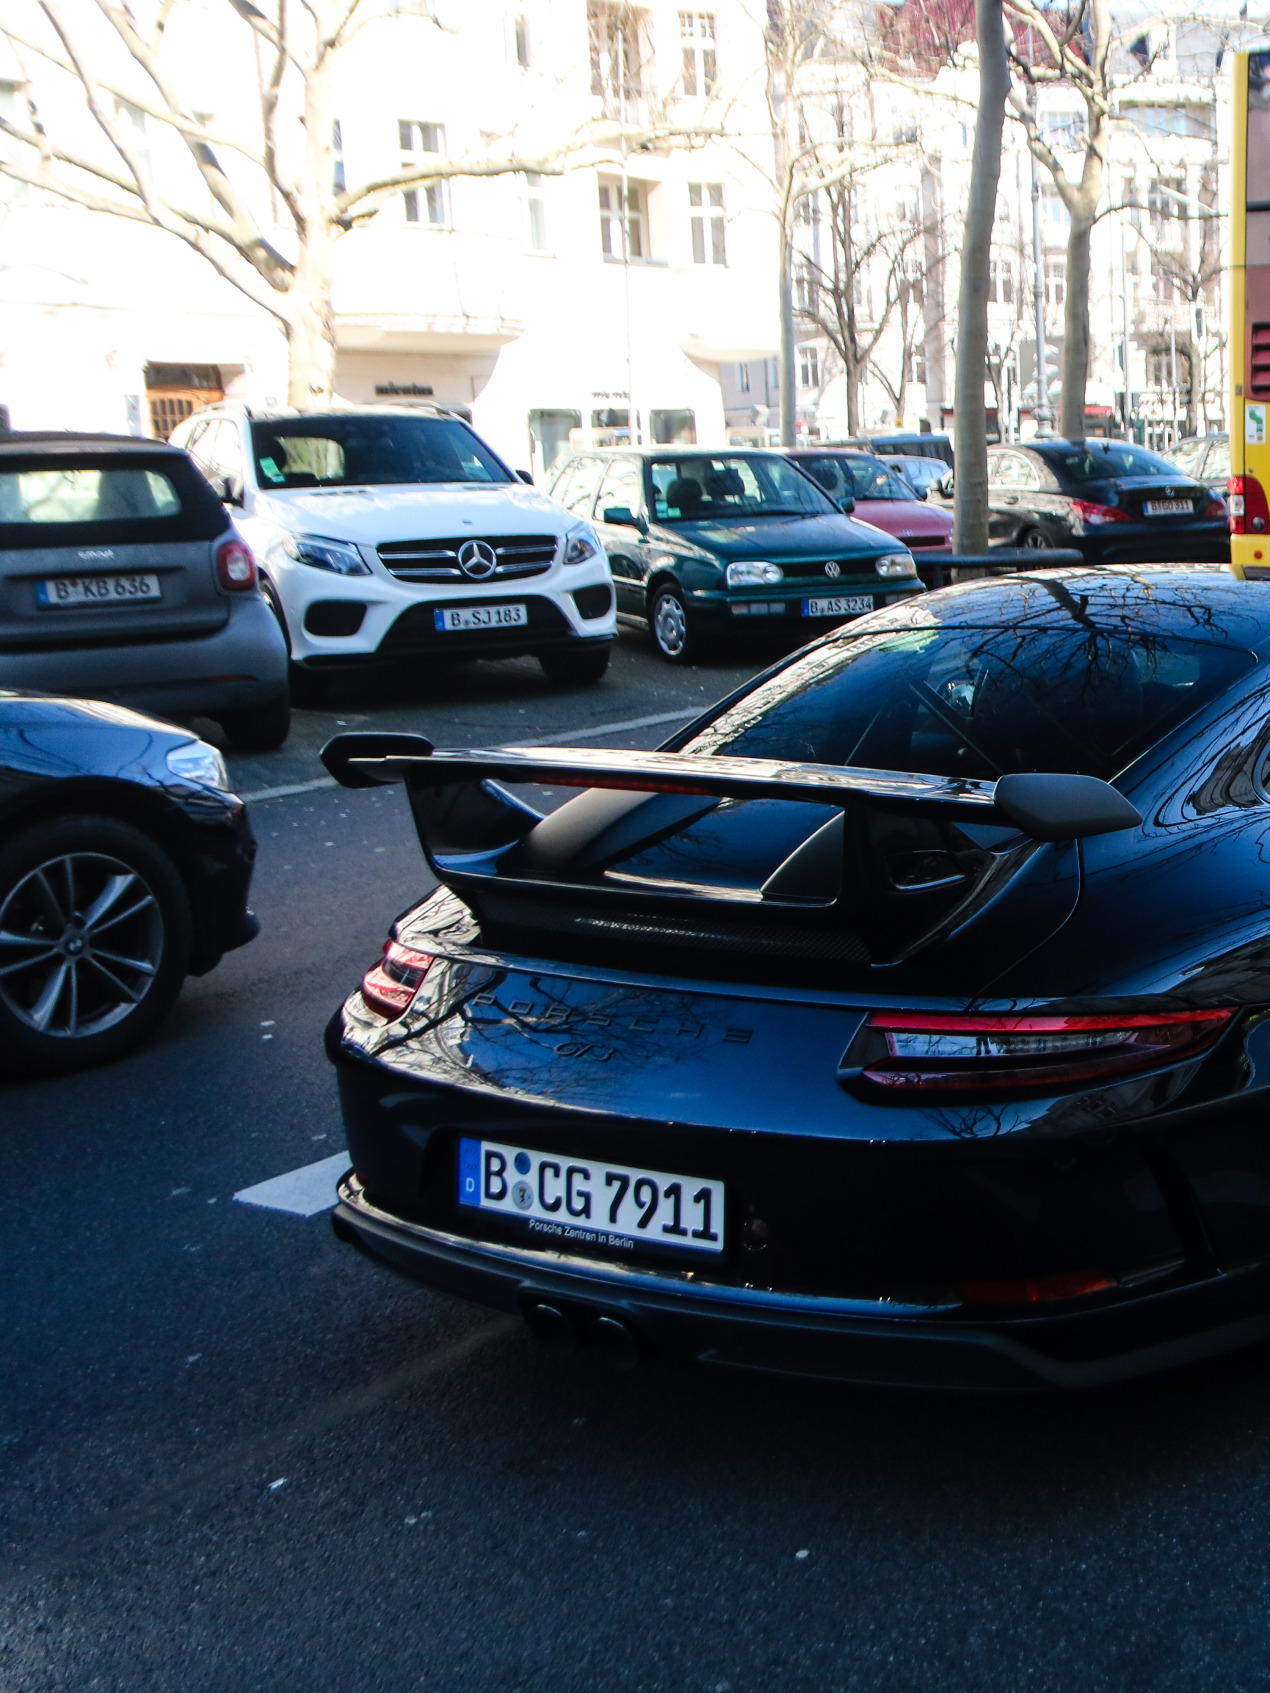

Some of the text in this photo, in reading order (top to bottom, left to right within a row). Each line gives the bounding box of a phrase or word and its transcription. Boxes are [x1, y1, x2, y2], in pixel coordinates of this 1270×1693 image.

[56, 575, 151, 600] B KB 636
[451, 606, 521, 627] B SJ 183
[810, 597, 873, 614] B AS 3234
[473, 994, 754, 1044] PORSCHE
[465, 1178, 474, 1192] D
[484, 1149, 719, 1242] B CG 7911
[529, 1219, 634, 1249] Porsche Zentren in Berlin
